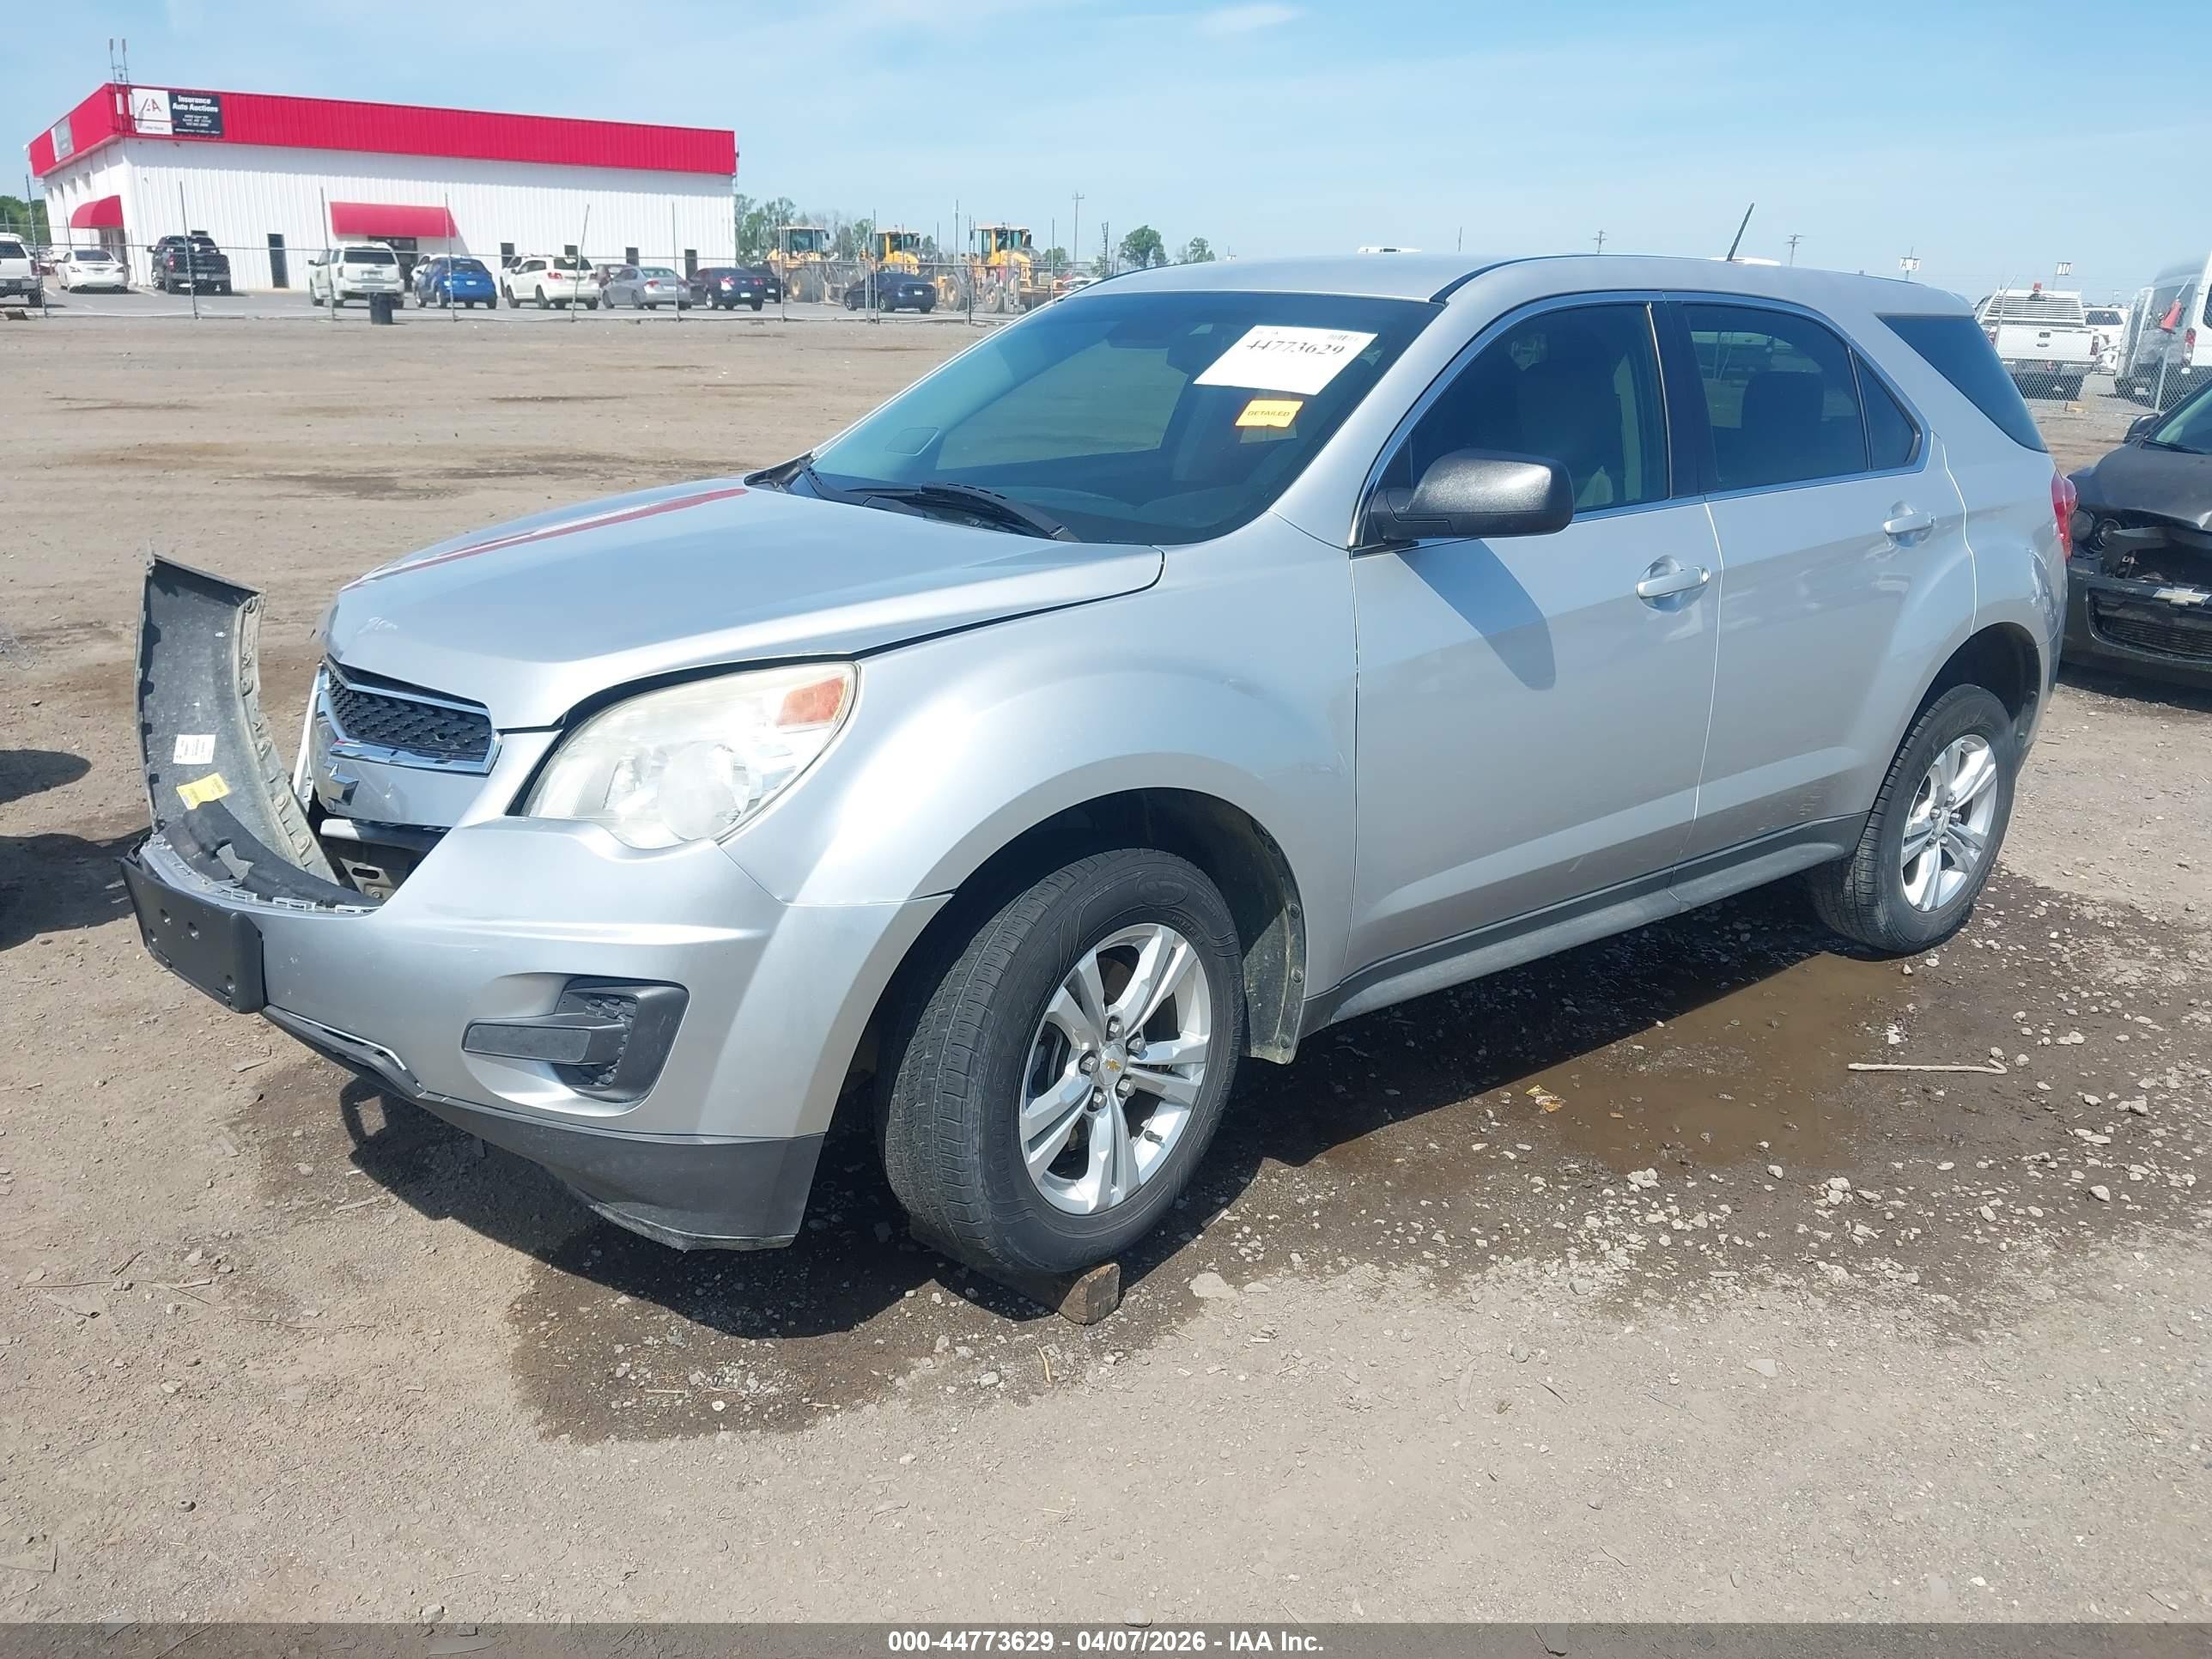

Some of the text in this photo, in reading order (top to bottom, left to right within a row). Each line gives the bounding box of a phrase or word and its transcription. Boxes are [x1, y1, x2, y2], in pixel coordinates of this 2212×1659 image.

[177, 95, 211, 104] Insurance
[172, 102, 219, 112] Auto Auctions
[1245, 339, 1346, 355] 44773629
